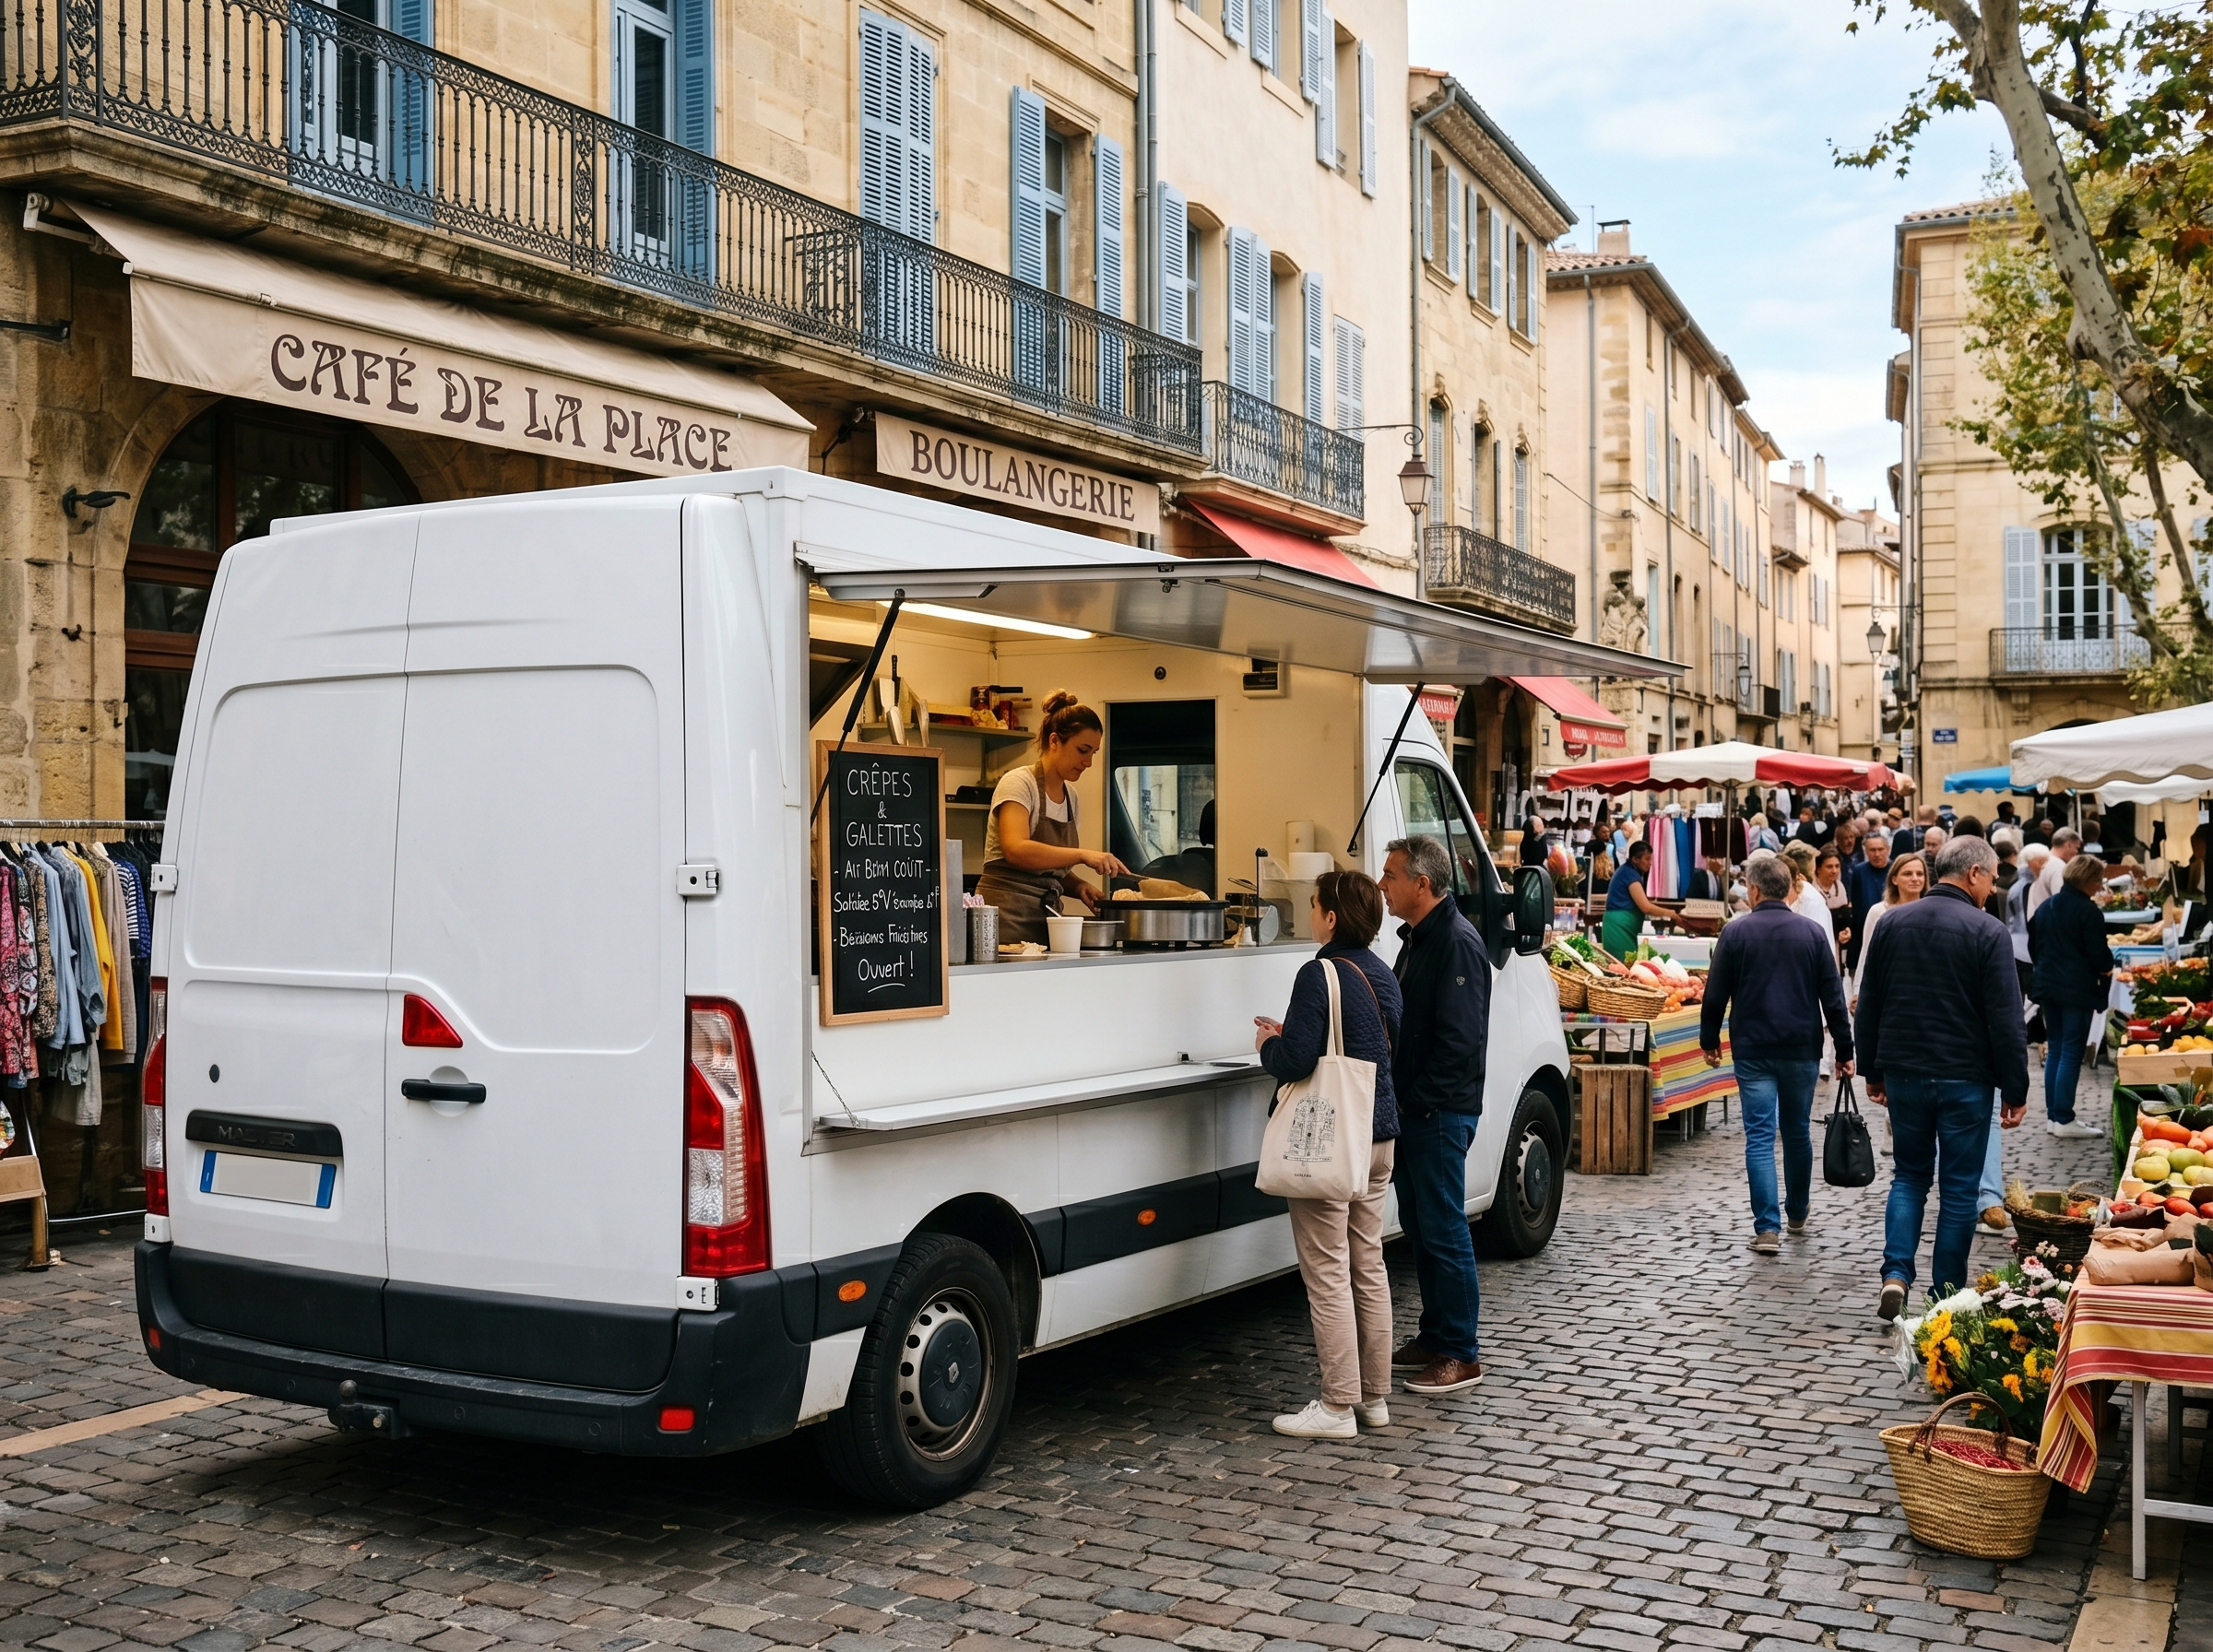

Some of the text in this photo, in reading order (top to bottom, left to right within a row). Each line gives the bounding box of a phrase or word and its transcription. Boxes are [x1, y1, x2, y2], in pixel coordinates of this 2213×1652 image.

[271, 333, 733, 472] CAFÉ DE LA PLACE
[908, 429, 1136, 523] BOULANGERIE
[846, 761, 913, 798] CRÊPES
[877, 800, 887, 820] &
[846, 821, 923, 848] GALETTES
[858, 954, 905, 982] Ouvert
